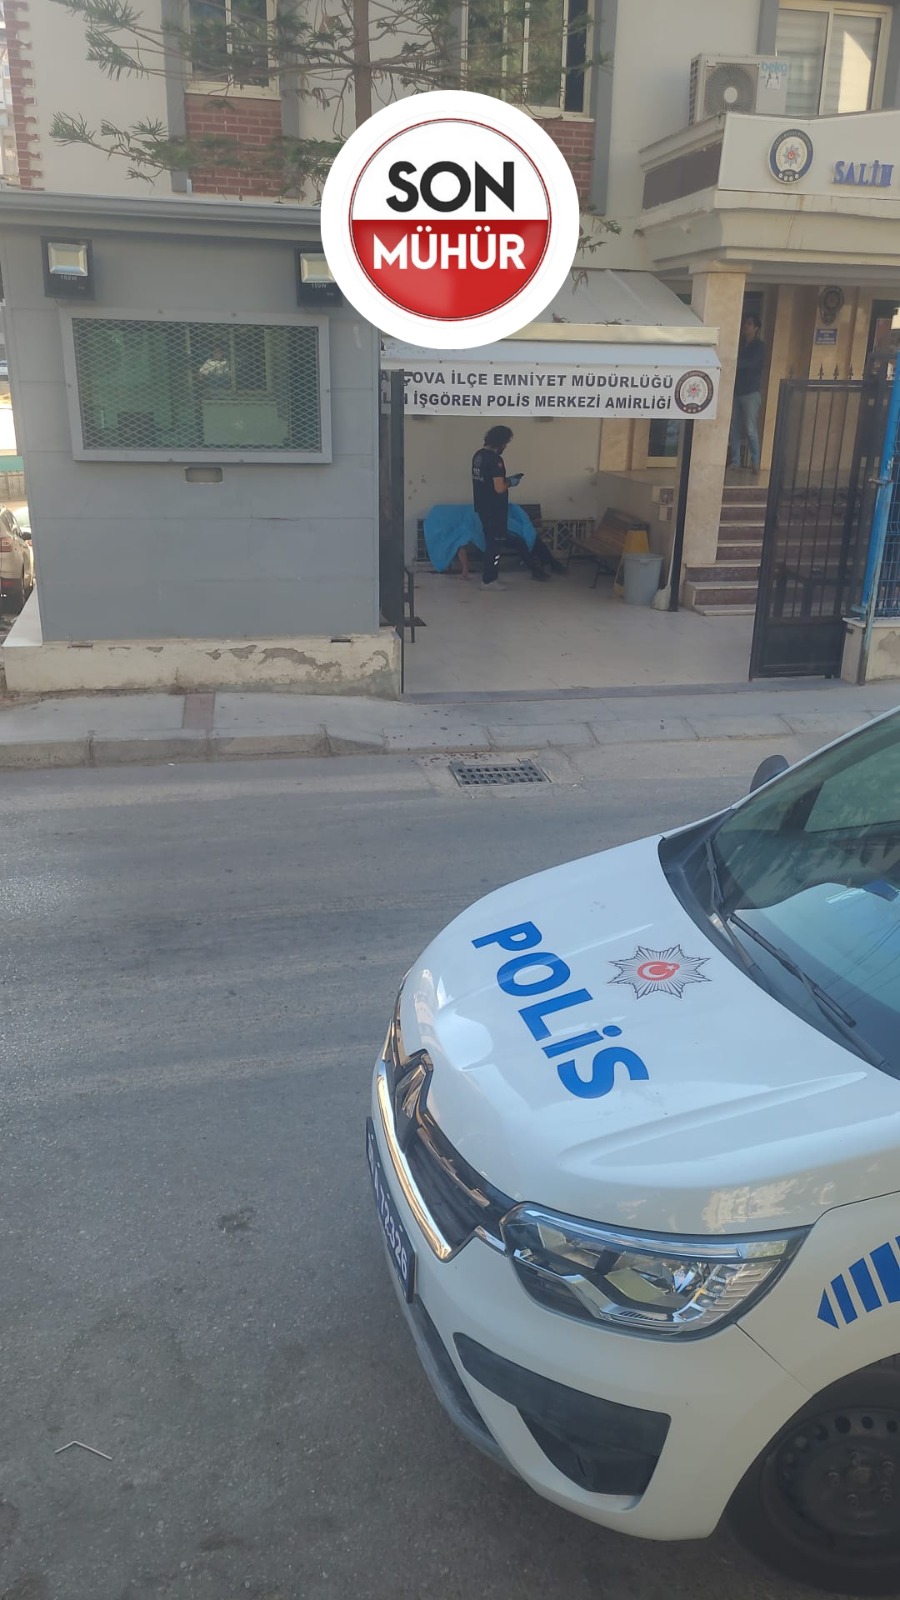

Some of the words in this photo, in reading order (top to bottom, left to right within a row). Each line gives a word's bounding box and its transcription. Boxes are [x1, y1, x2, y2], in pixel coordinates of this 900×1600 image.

[451, 370, 488, 388] İLÇE
[493, 371, 567, 386] EMNİYET
[571, 372, 673, 389] MÜDÜRLÜĞÜ
[413, 390, 482, 408] İŞGÖREN
[487, 393, 530, 407] POLİS
[534, 394, 601, 408] MERKEZİ
[605, 394, 672, 410] AMİRLİĞİ
